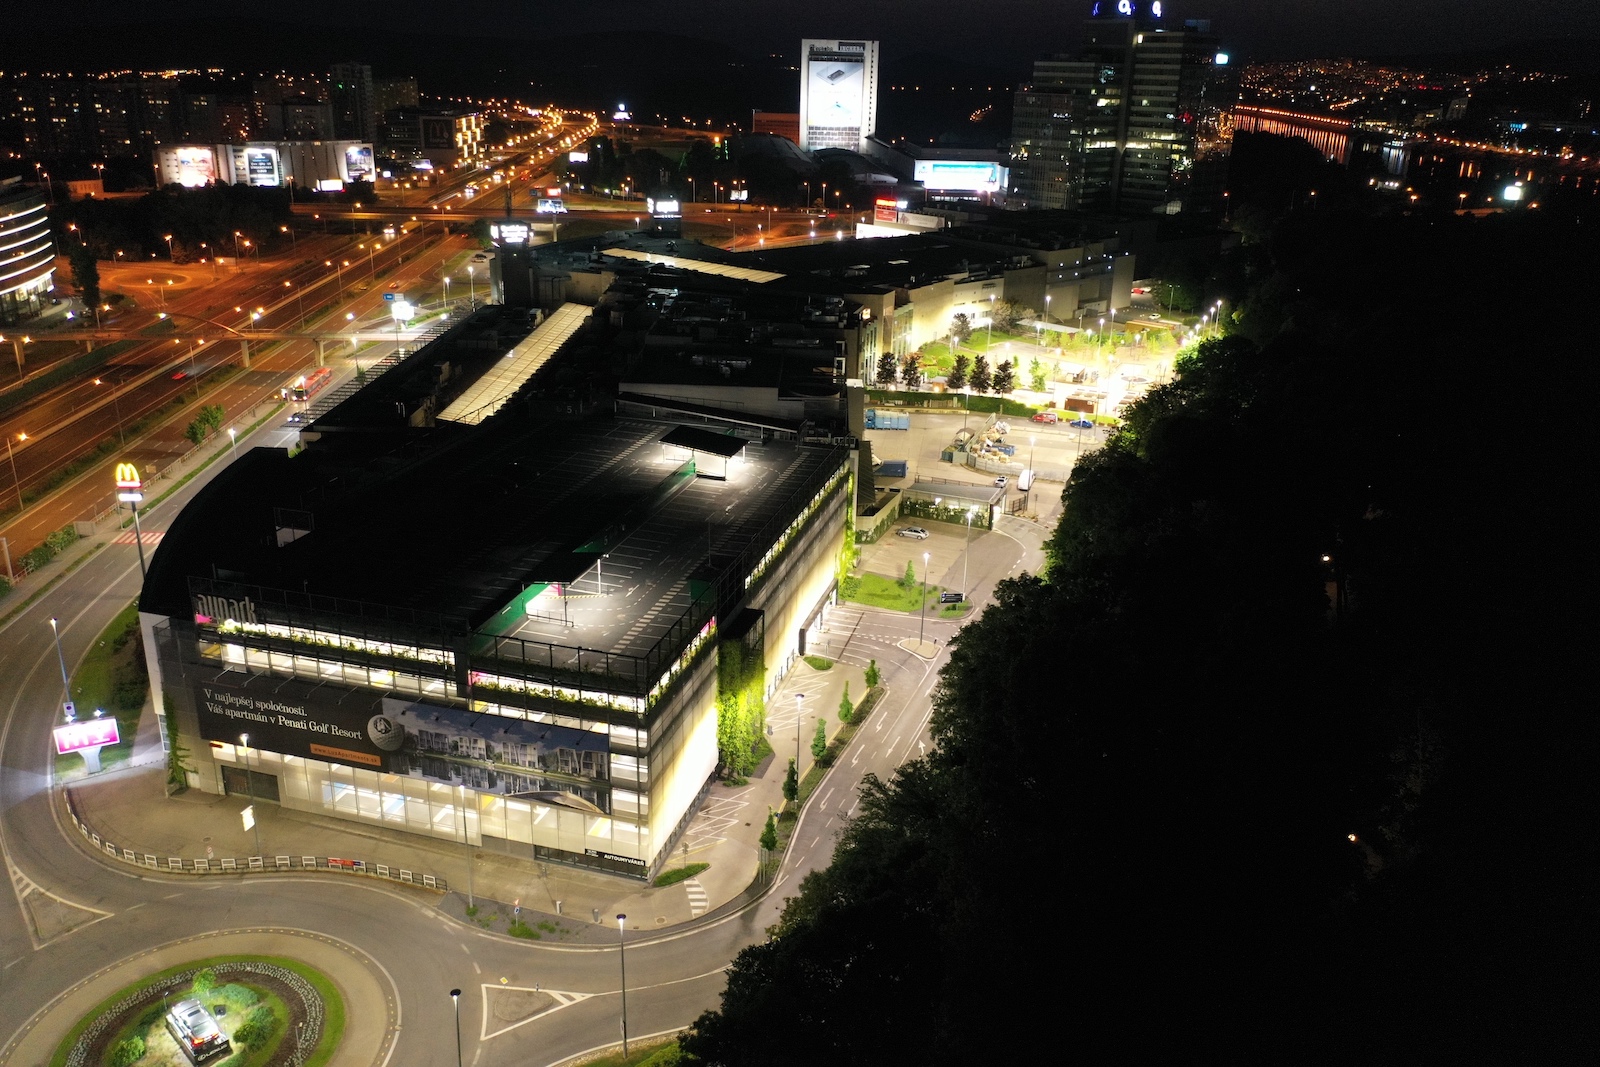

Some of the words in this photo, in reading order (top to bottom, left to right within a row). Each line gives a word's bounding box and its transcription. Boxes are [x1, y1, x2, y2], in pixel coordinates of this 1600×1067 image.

[204, 688, 212, 699] V
[214, 692, 254, 710] najlepšej
[255, 700, 308, 717] spoločnosti.
[206, 702, 224, 715] Váš
[225, 708, 268, 723] apartmán
[269, 716, 276, 724] v
[277, 714, 307, 730] Penati
[309, 720, 330, 734] Golf
[331, 724, 362, 740] Resort
